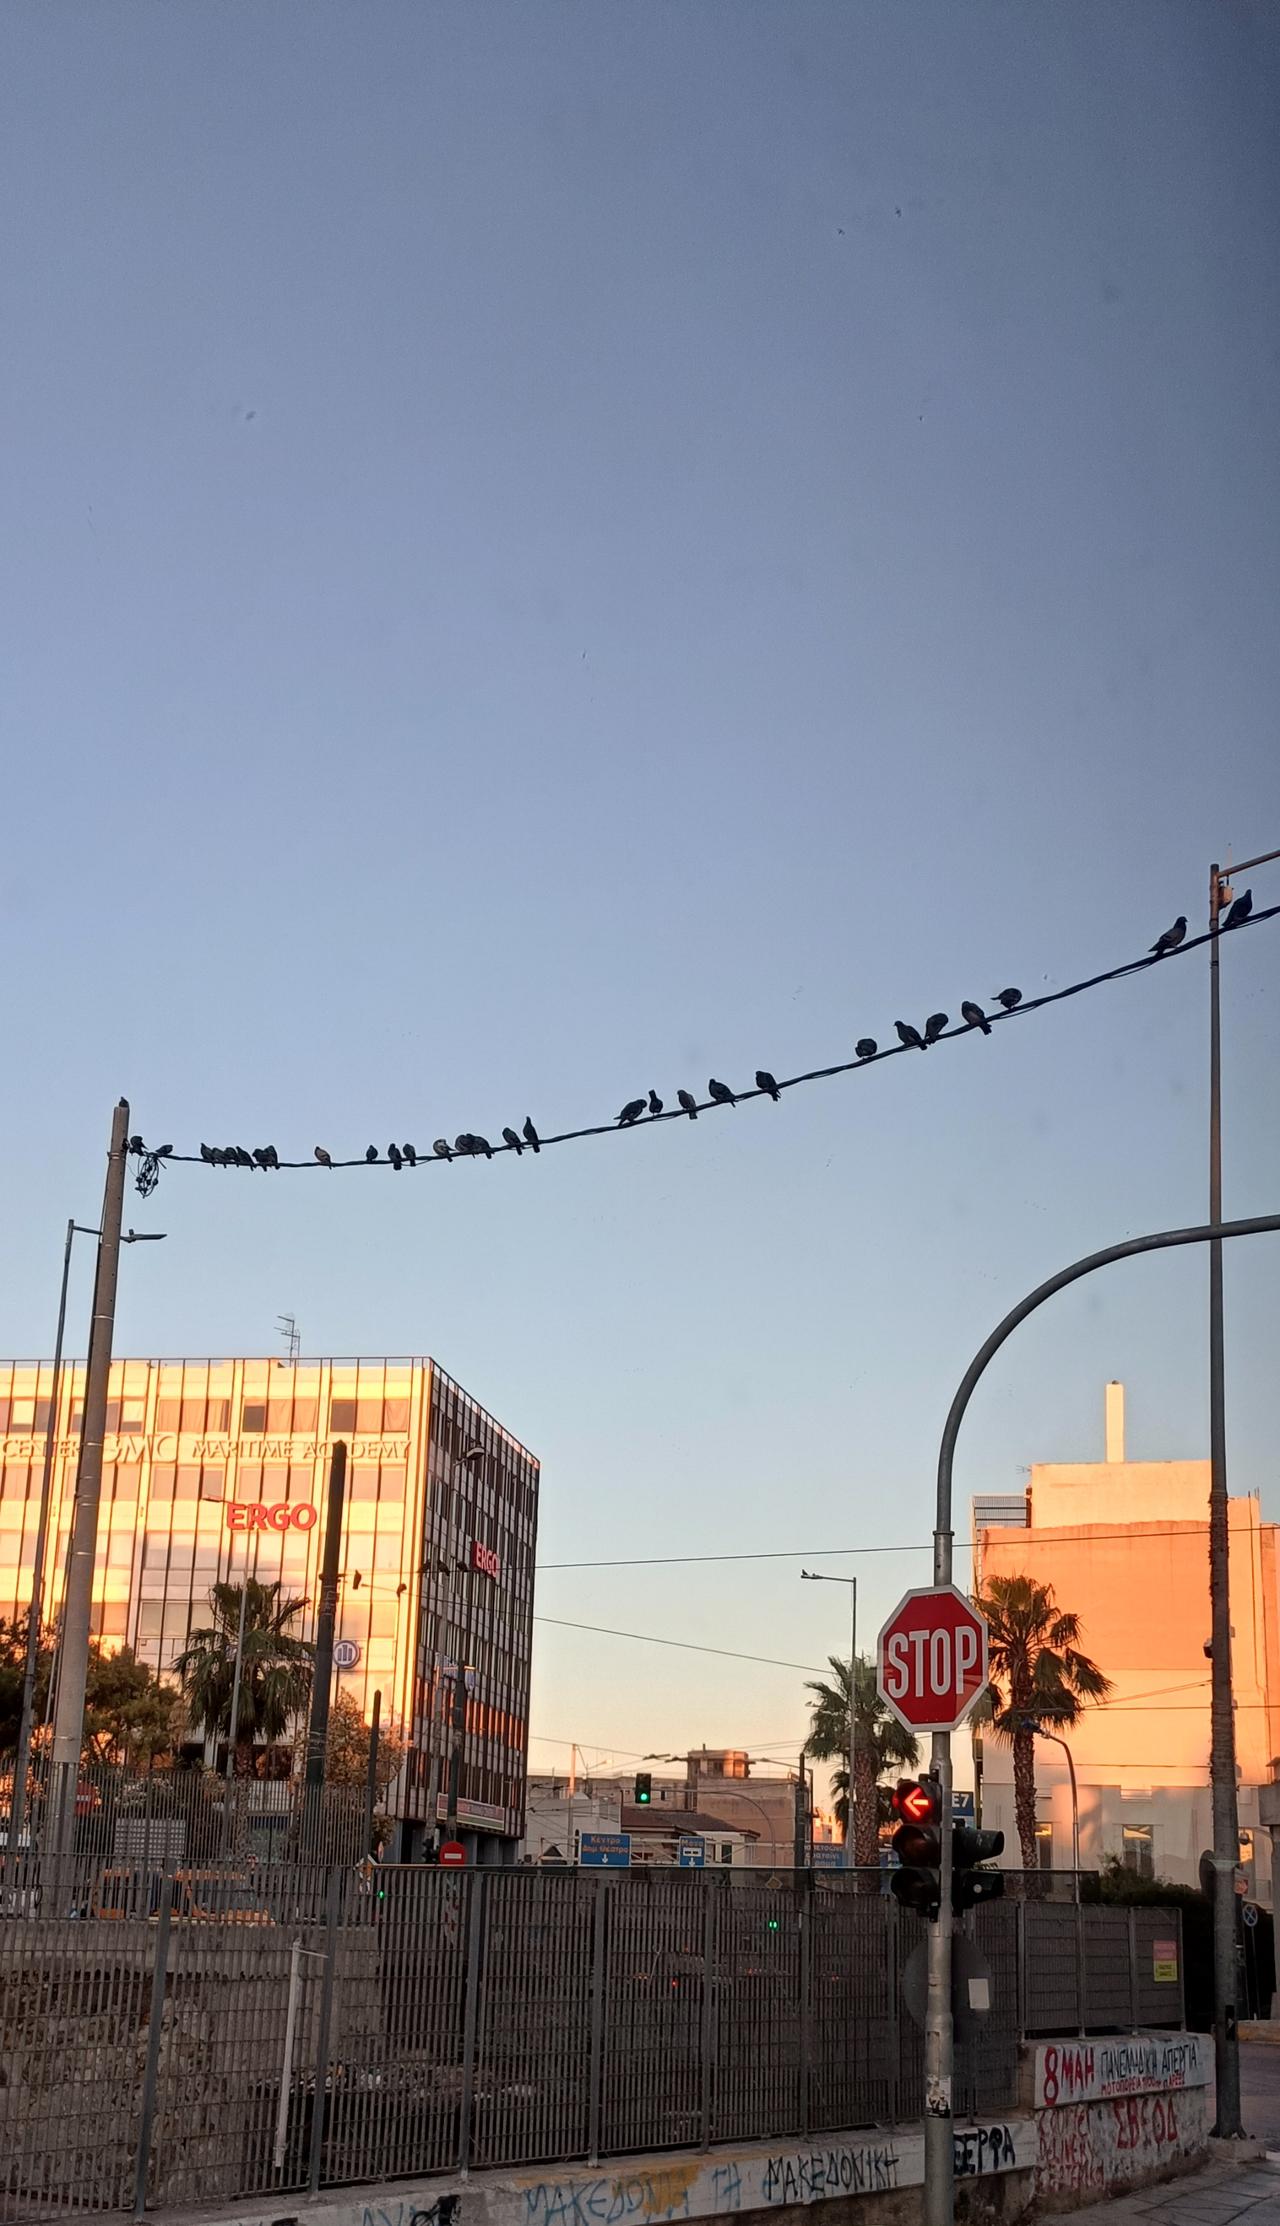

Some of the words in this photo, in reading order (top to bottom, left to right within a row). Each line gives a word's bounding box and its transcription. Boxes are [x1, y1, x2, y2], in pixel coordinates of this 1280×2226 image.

[192, 1440, 293, 1458] MARITIME
[304, 1440, 411, 1459] ACDEMY
[227, 1503, 317, 1531] ERGO
[476, 1540, 498, 1578] ERGO
[888, 1625, 978, 1699] STOP
[1044, 2046, 1059, 2106] 8
